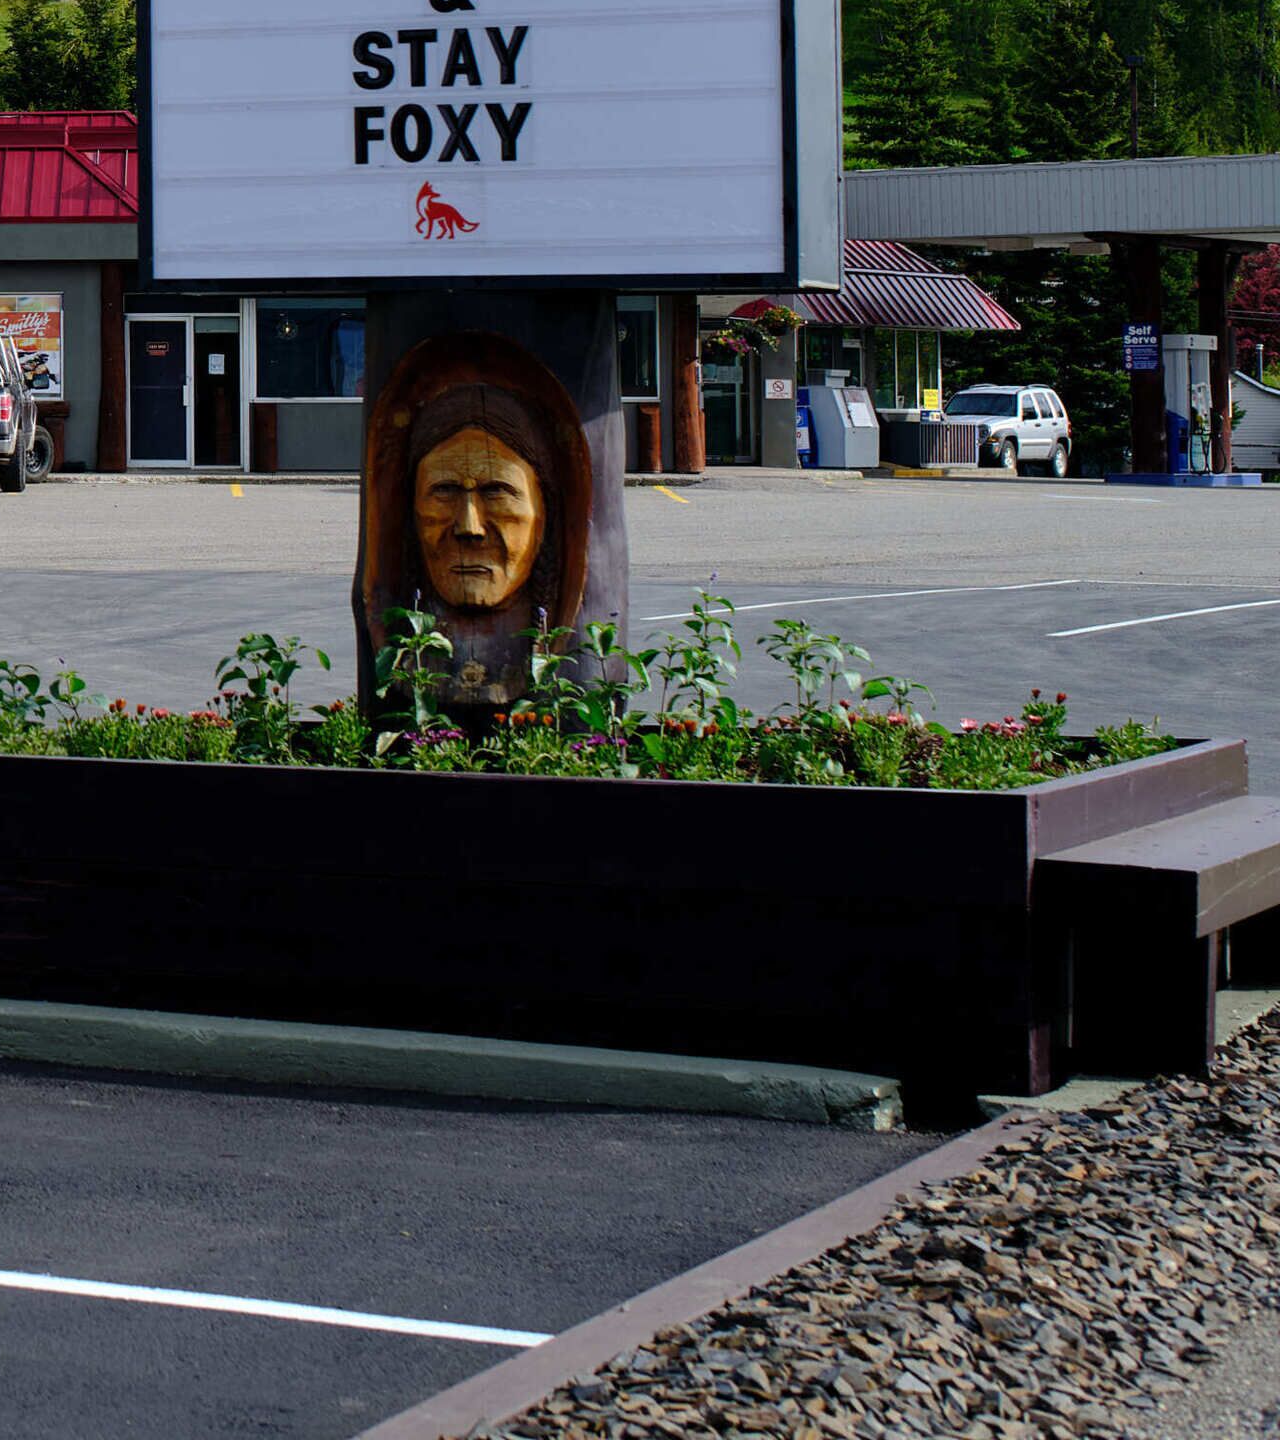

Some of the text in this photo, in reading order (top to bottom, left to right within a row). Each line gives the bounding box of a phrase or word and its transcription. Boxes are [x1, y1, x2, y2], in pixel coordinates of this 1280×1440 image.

[352, 24, 530, 90] STAY
[352, 102, 533, 165] FOXY
[1124, 335, 1157, 344] Serve
[1128, 325, 1152, 335] Self
